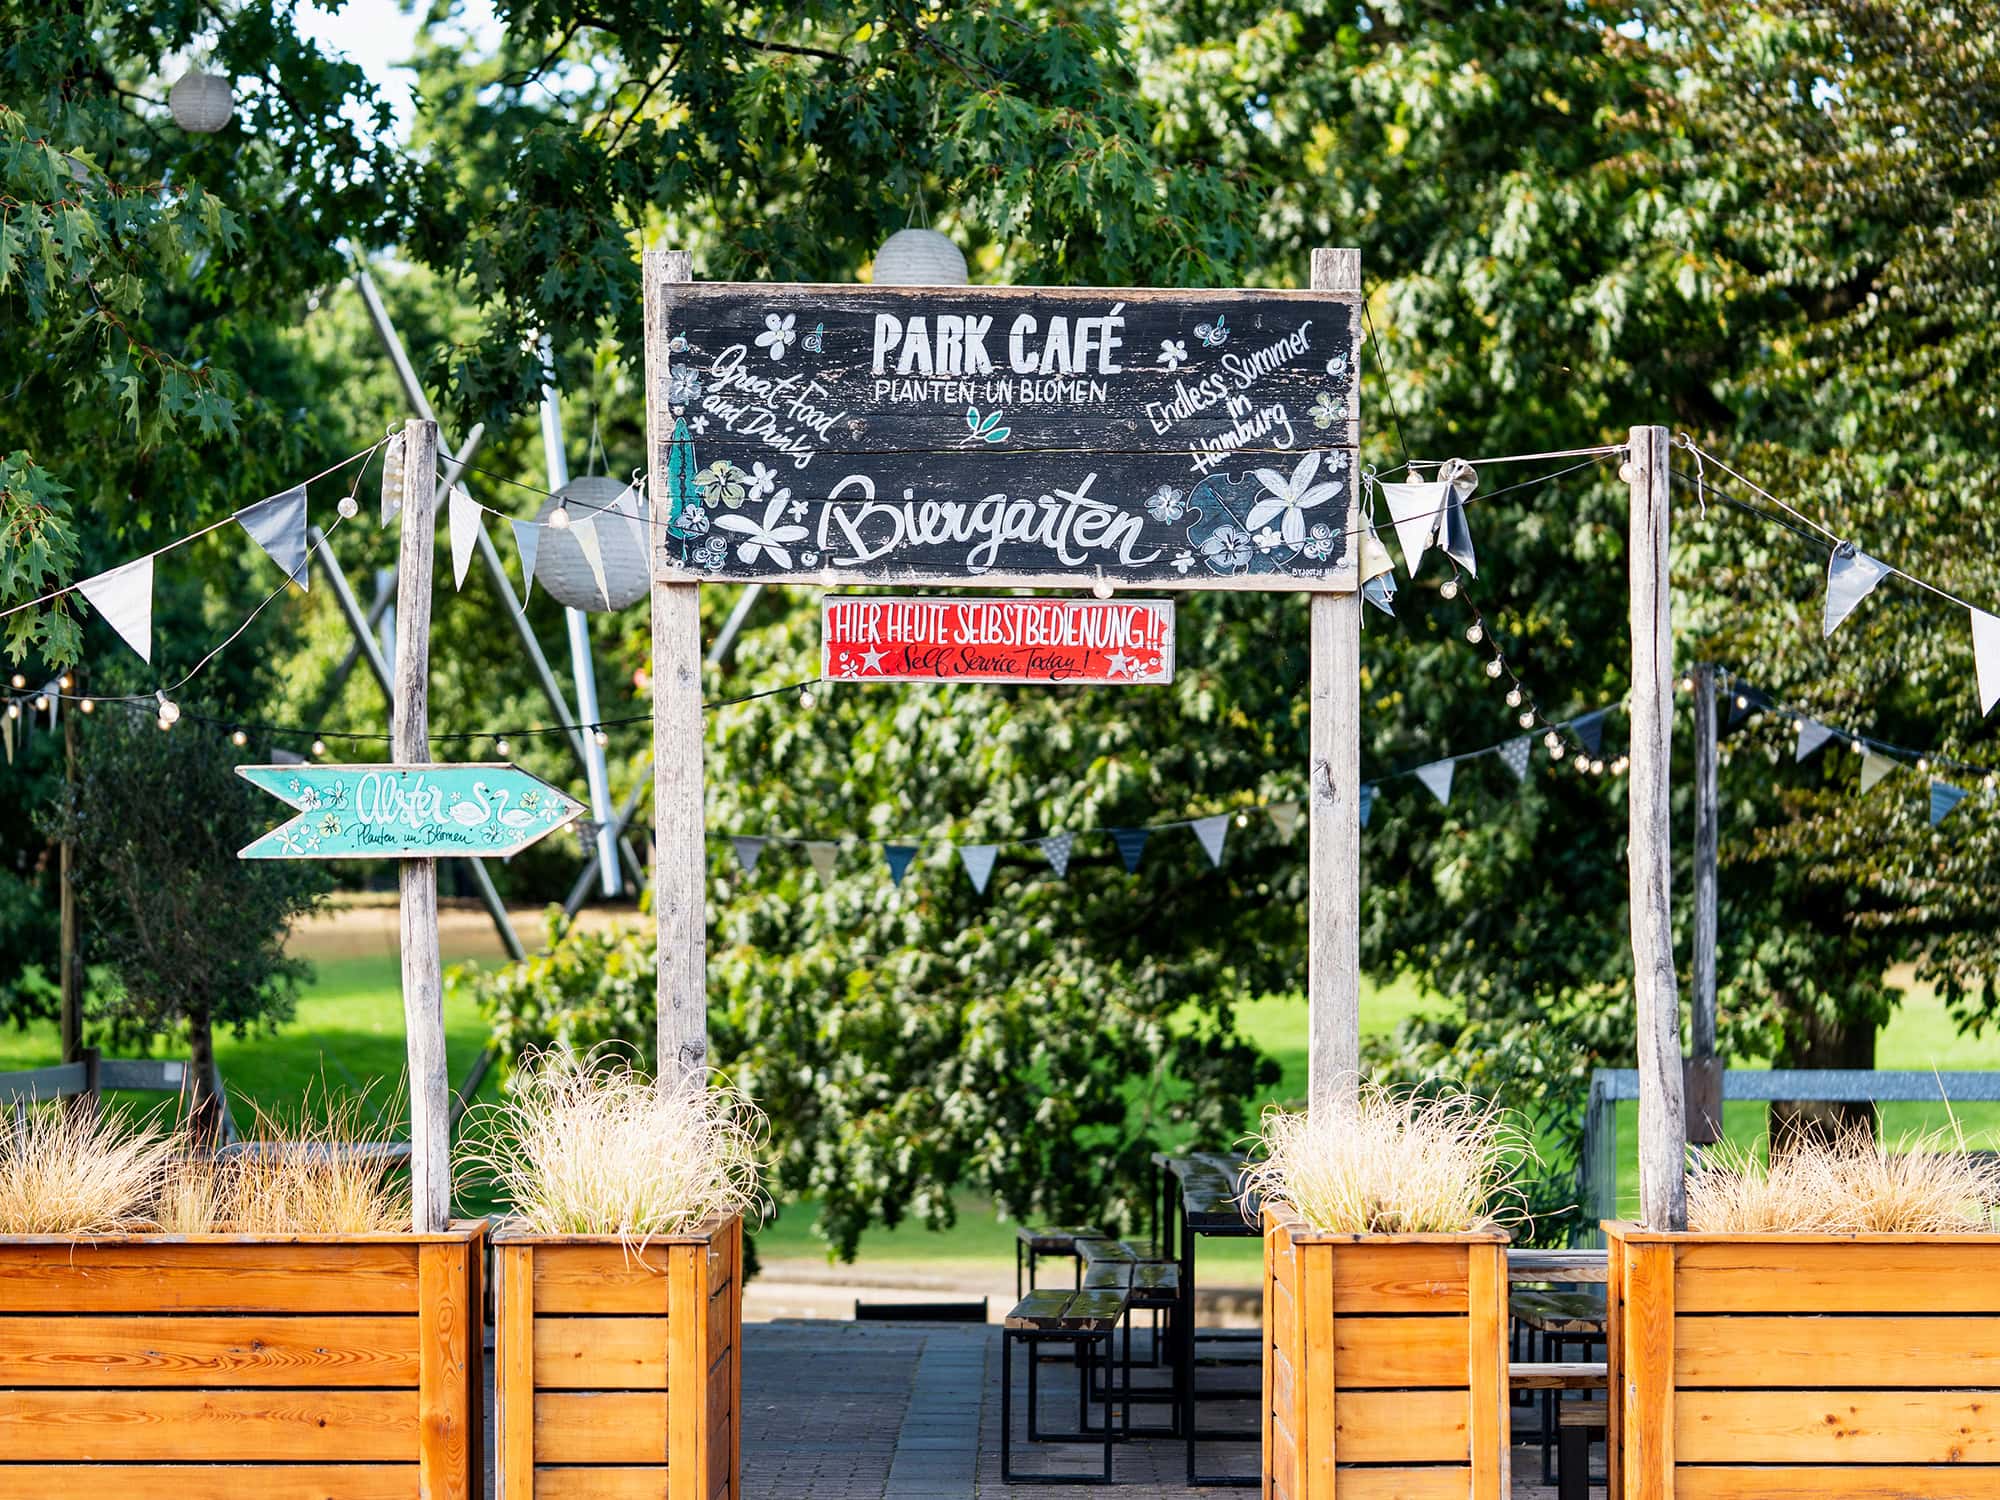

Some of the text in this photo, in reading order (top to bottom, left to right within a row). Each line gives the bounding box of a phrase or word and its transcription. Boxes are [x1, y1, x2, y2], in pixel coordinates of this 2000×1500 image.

[873, 302, 1125, 375] PARK CAFÉ
[707, 345, 846, 443] Great Food
[875, 379, 1107, 403] PLANTEN UN BLOMEN
[1146, 320, 1312, 436] Endless Summer
[1227, 394, 1251, 419] in
[702, 395, 816, 469] and Drinks
[1190, 403, 1295, 475] Hamburg
[817, 472, 1162, 574] Biergarten
[834, 602, 1160, 650] HIER HEUTE SELBSTBEDIENUNG!!
[897, 644, 955, 677] Self
[954, 646, 1019, 674] Service
[356, 772, 450, 829] Alster
[344, 823, 397, 846] Planten
[419, 824, 474, 845] Blomen
